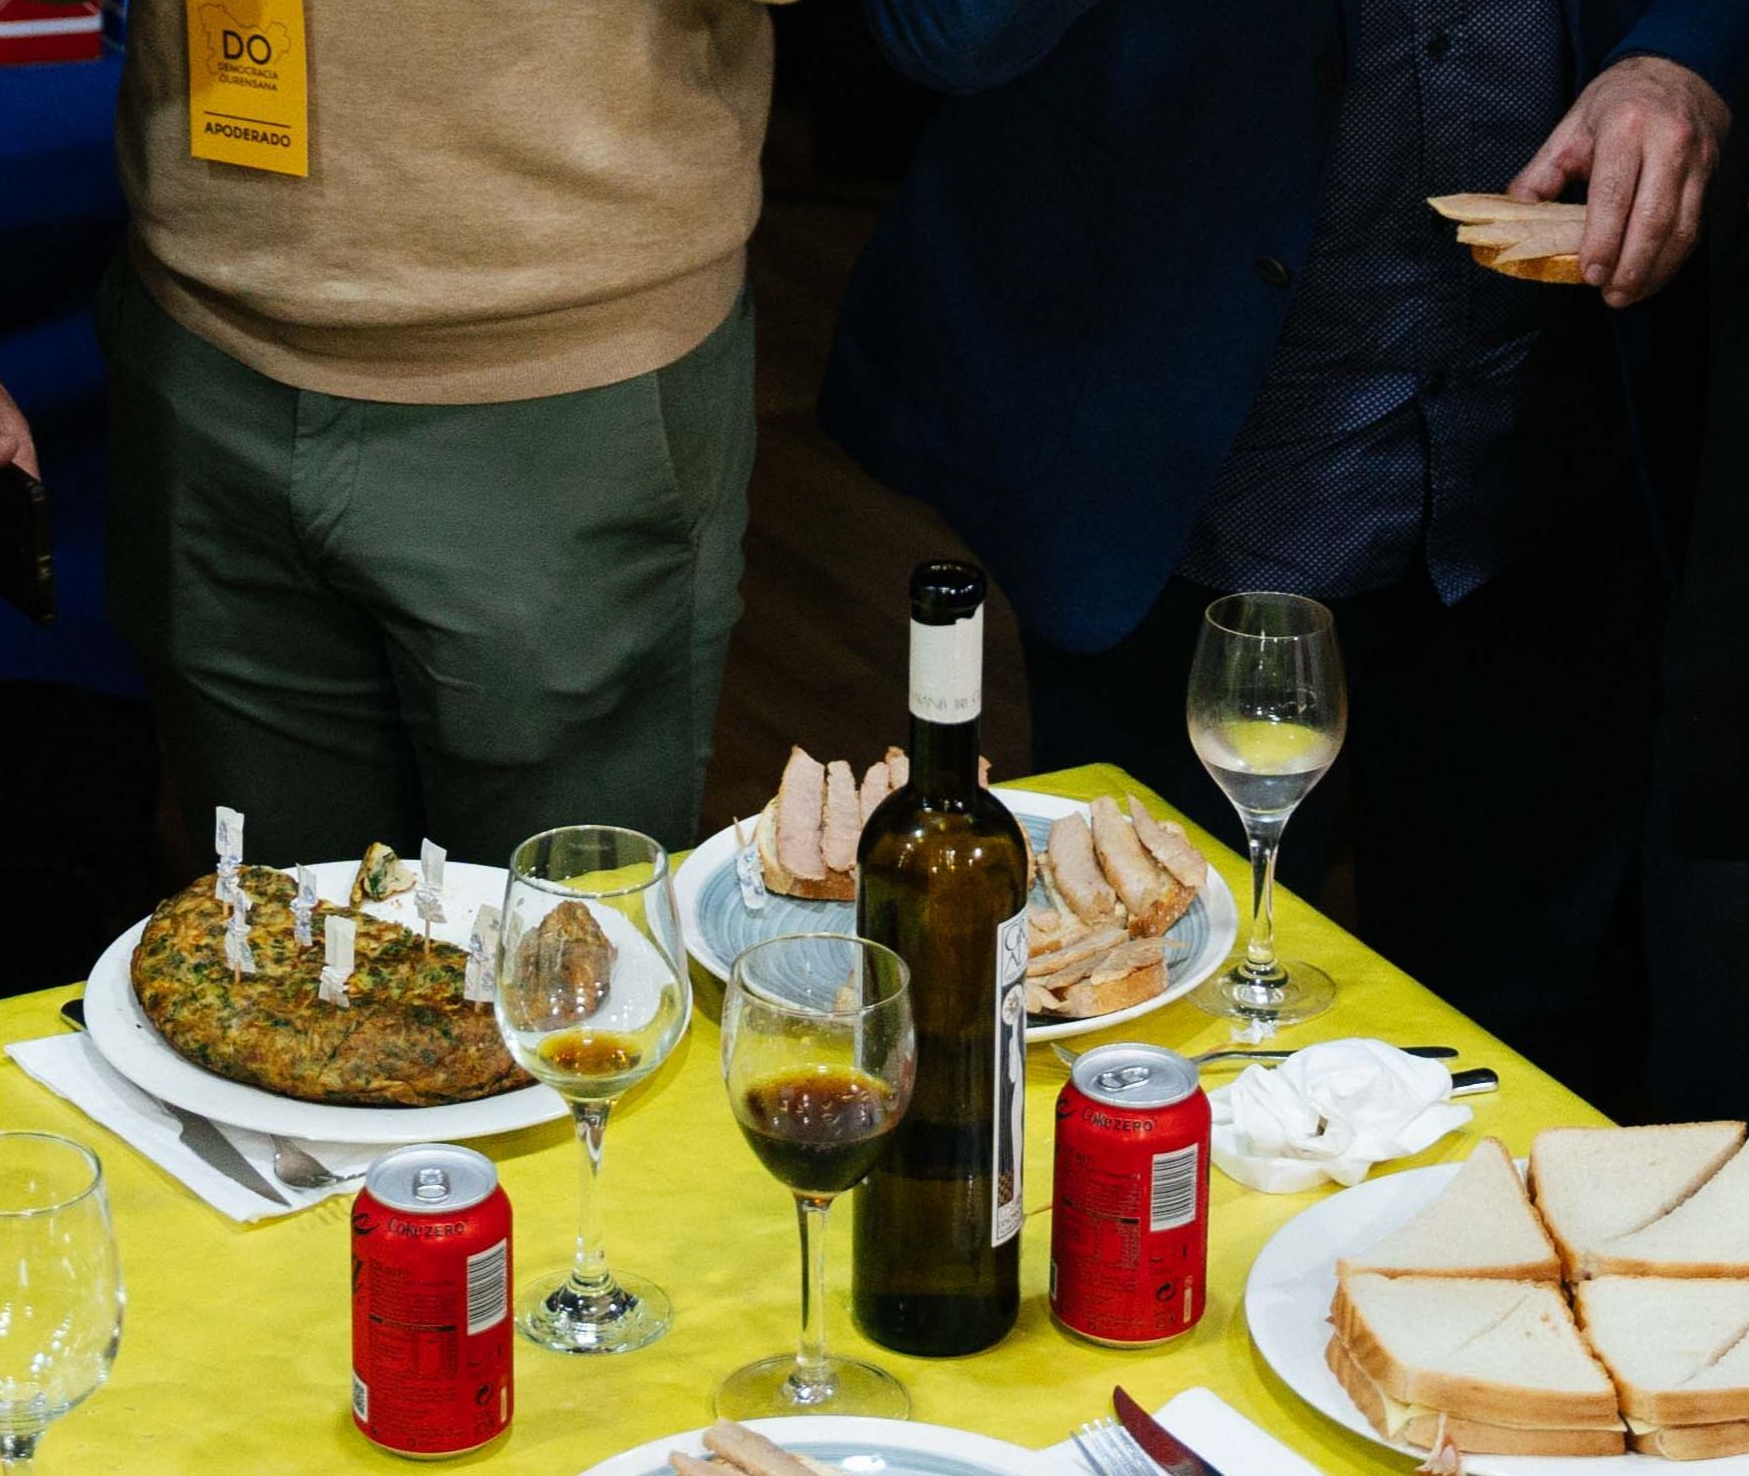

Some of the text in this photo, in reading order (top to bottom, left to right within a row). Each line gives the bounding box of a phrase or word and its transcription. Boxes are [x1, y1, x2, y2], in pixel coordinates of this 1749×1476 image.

[222, 29, 272, 65] DO
[217, 61, 279, 81] DEMOCRACIA
[218, 74, 278, 92] OURENSANA
[204, 121, 291, 148] APODERADO
[1113, 1119, 1154, 1132] ZERO
[424, 1222, 466, 1237] ZERO
